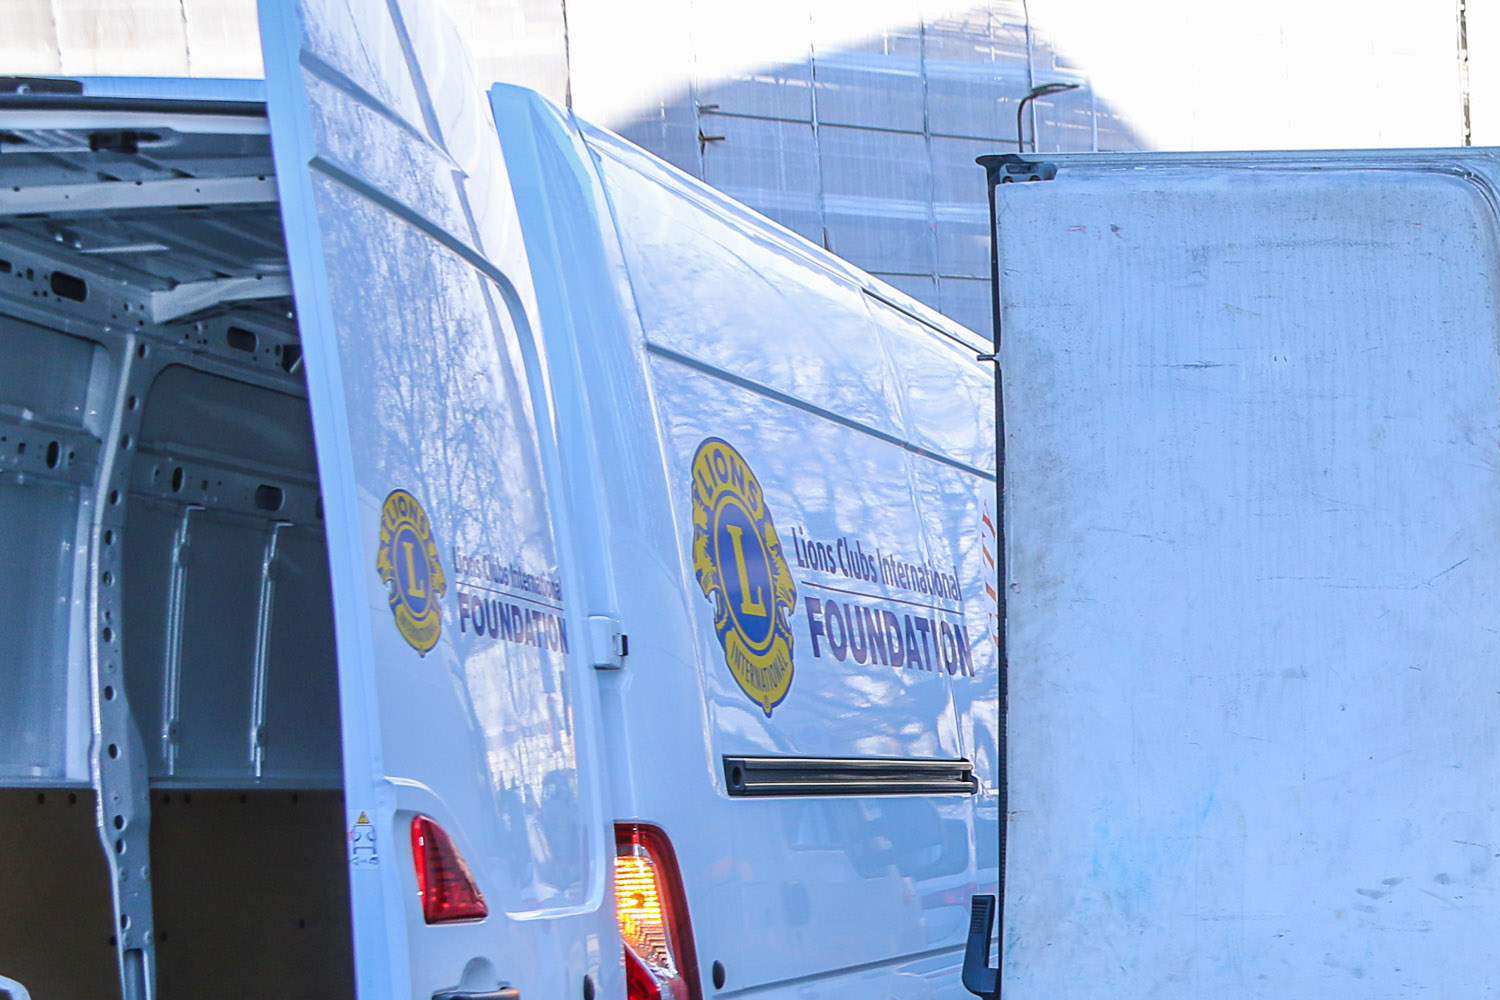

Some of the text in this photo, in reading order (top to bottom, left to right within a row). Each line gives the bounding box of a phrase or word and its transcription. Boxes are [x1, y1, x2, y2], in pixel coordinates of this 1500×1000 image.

[697, 448, 760, 512] LIONS
[384, 495, 430, 536] LIONS
[452, 546, 563, 602] Lions Clubs International
[726, 524, 767, 617] L
[791, 526, 963, 602] Lions Clubs International
[457, 592, 569, 655] FOUNDATION
[804, 596, 976, 678] FOUNDATION
[731, 640, 789, 692] INTERNATIONAL
